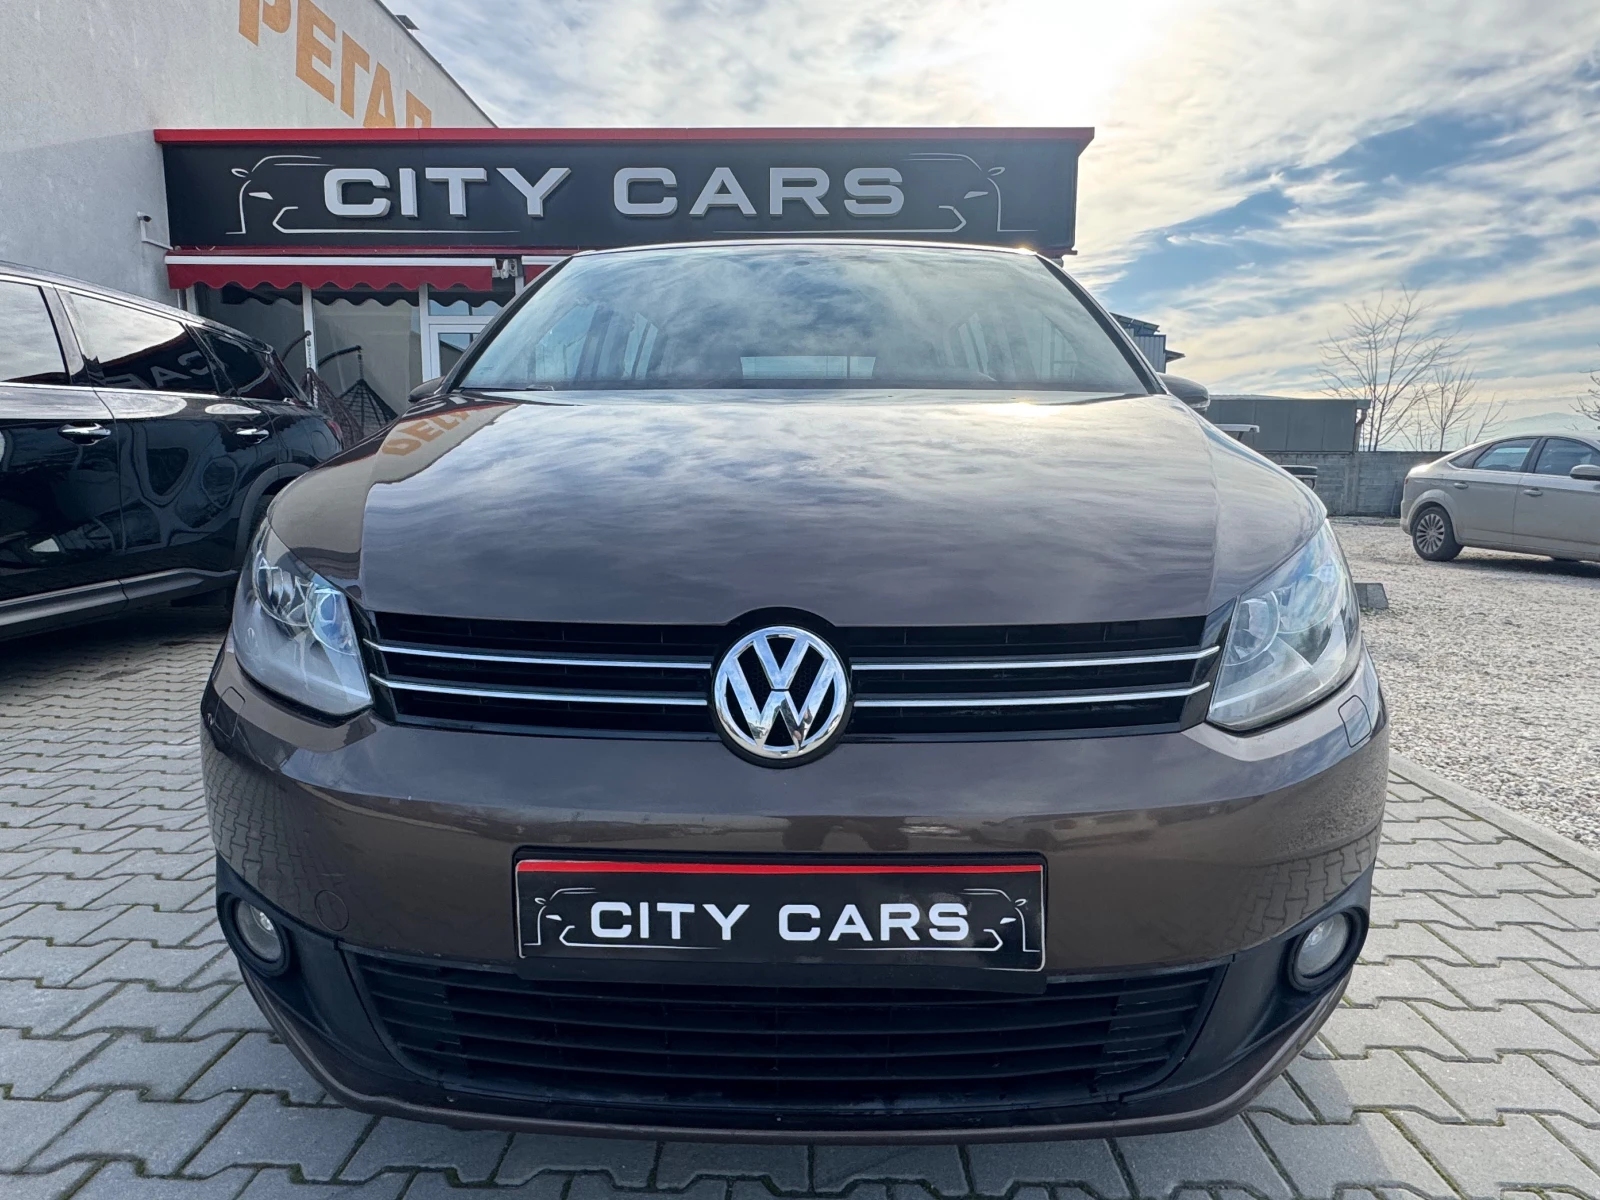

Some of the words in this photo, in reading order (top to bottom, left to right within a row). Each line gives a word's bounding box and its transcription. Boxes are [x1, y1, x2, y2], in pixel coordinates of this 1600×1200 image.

[324, 167, 571, 218] CITY
[613, 167, 905, 217] CARS
[716, 627, 846, 758] VW
[591, 901, 751, 941] CITY
[779, 903, 970, 942] CARS
